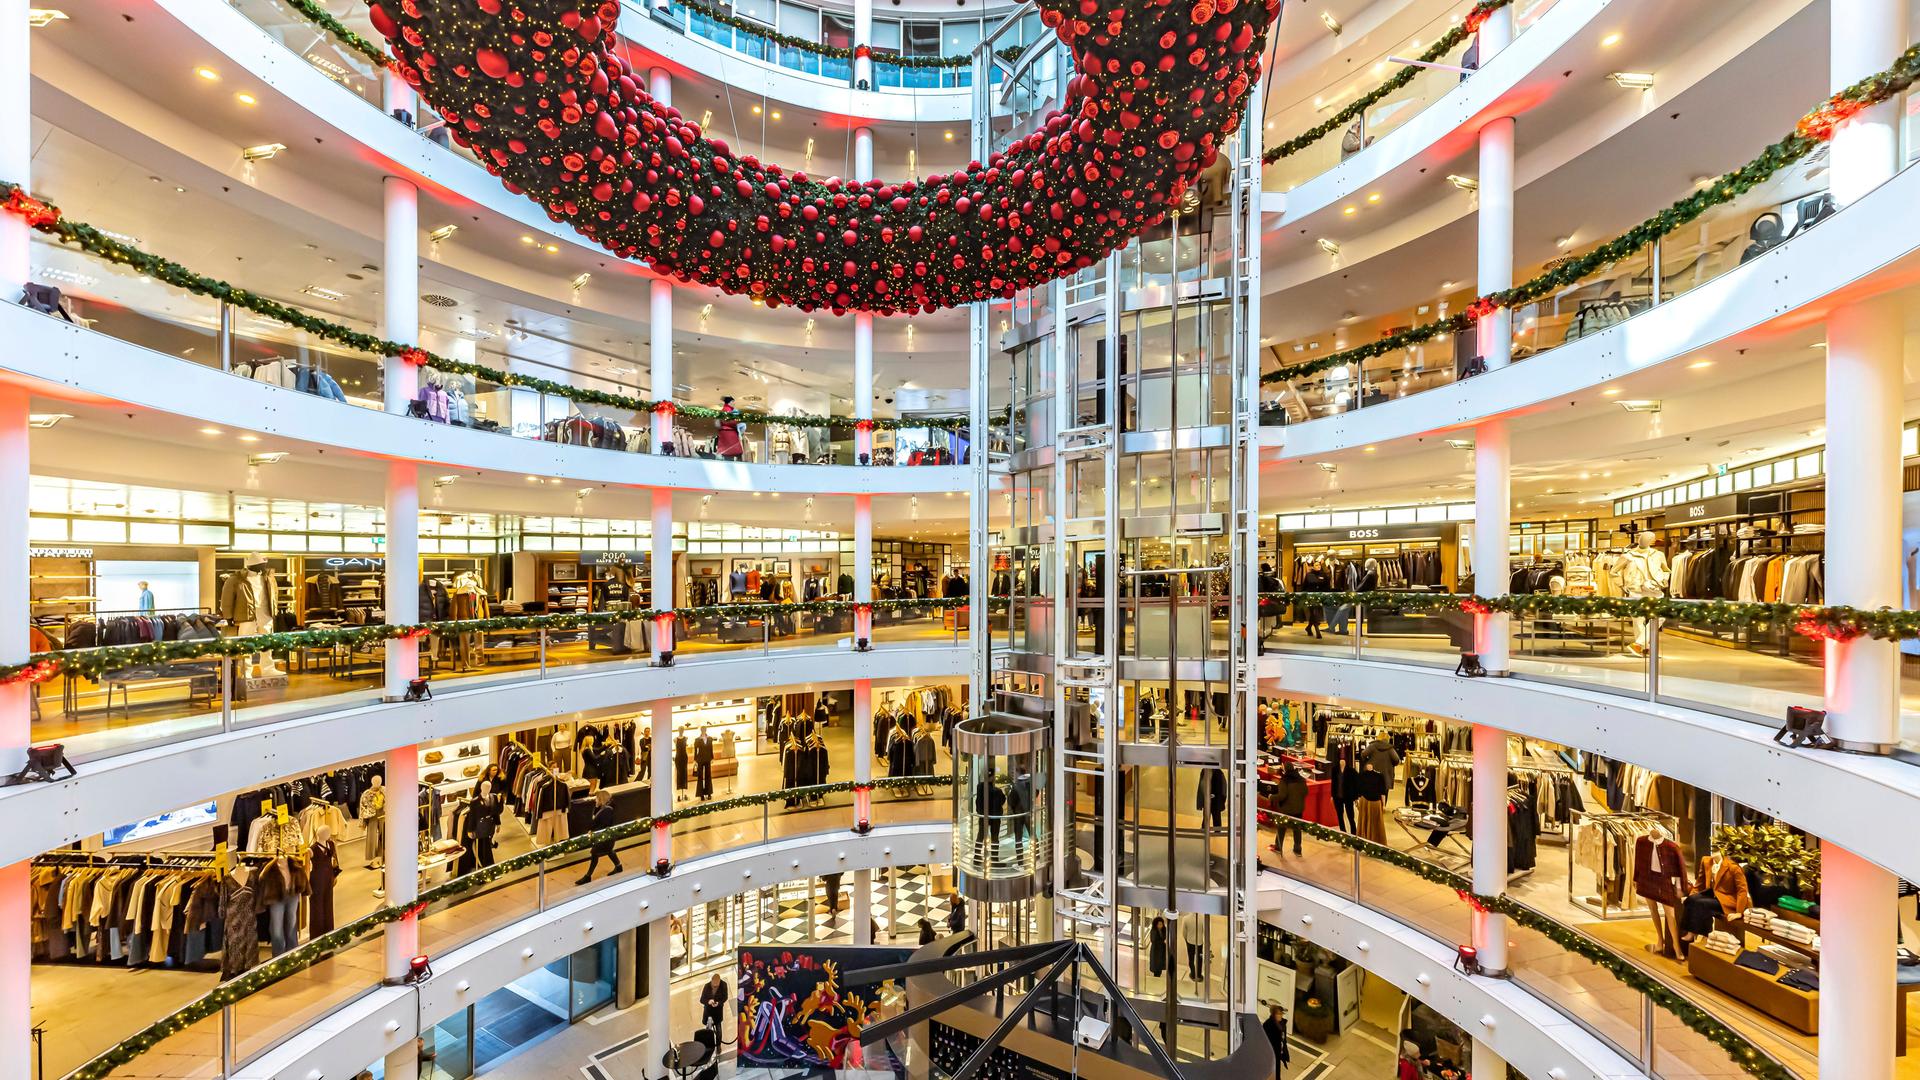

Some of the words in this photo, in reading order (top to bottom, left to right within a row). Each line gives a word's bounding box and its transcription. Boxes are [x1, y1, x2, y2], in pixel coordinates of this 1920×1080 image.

[1689, 505, 1705, 517] BOSS
[1349, 529, 1379, 539] BOSS
[602, 552, 626, 560] POLO
[326, 557, 383, 566] GAN
